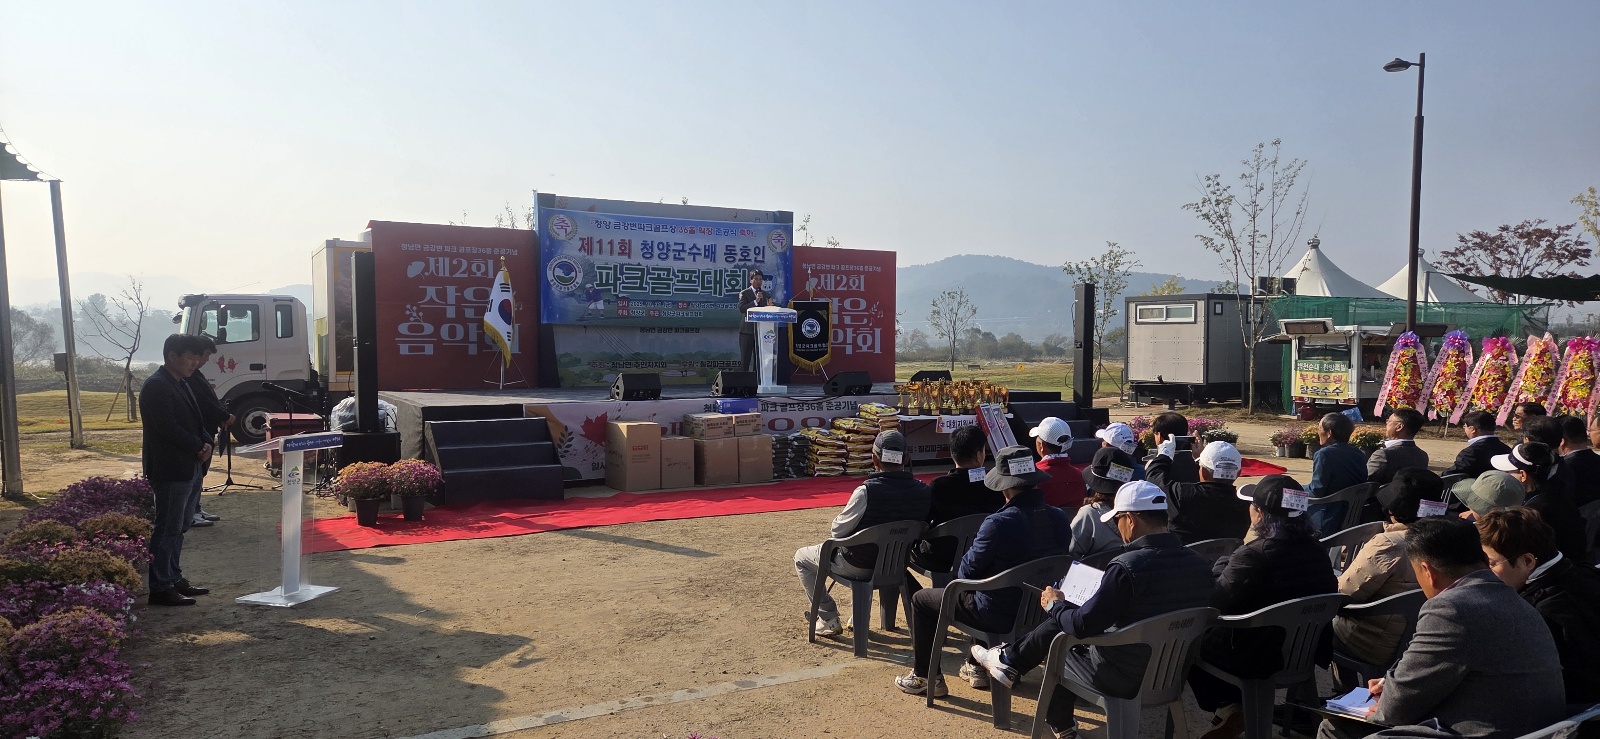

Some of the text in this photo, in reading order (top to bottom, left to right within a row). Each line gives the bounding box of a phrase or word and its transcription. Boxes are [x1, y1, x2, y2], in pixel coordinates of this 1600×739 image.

[553, 217, 571, 237] 축
[772, 231, 786, 247] 축
[444, 245, 457, 253] 파크
[578, 236, 766, 263] 제11회 청양군수배 동호인
[425, 256, 495, 279] 제2회
[594, 262, 748, 298] 파크골프대회
[817, 273, 866, 292] 제2회
[700, 361, 742, 369] 칠갑파크골프
[761, 402, 778, 412] 파크
[779, 402, 823, 413] 골프장36홀
[825, 401, 858, 411] 준공기념
